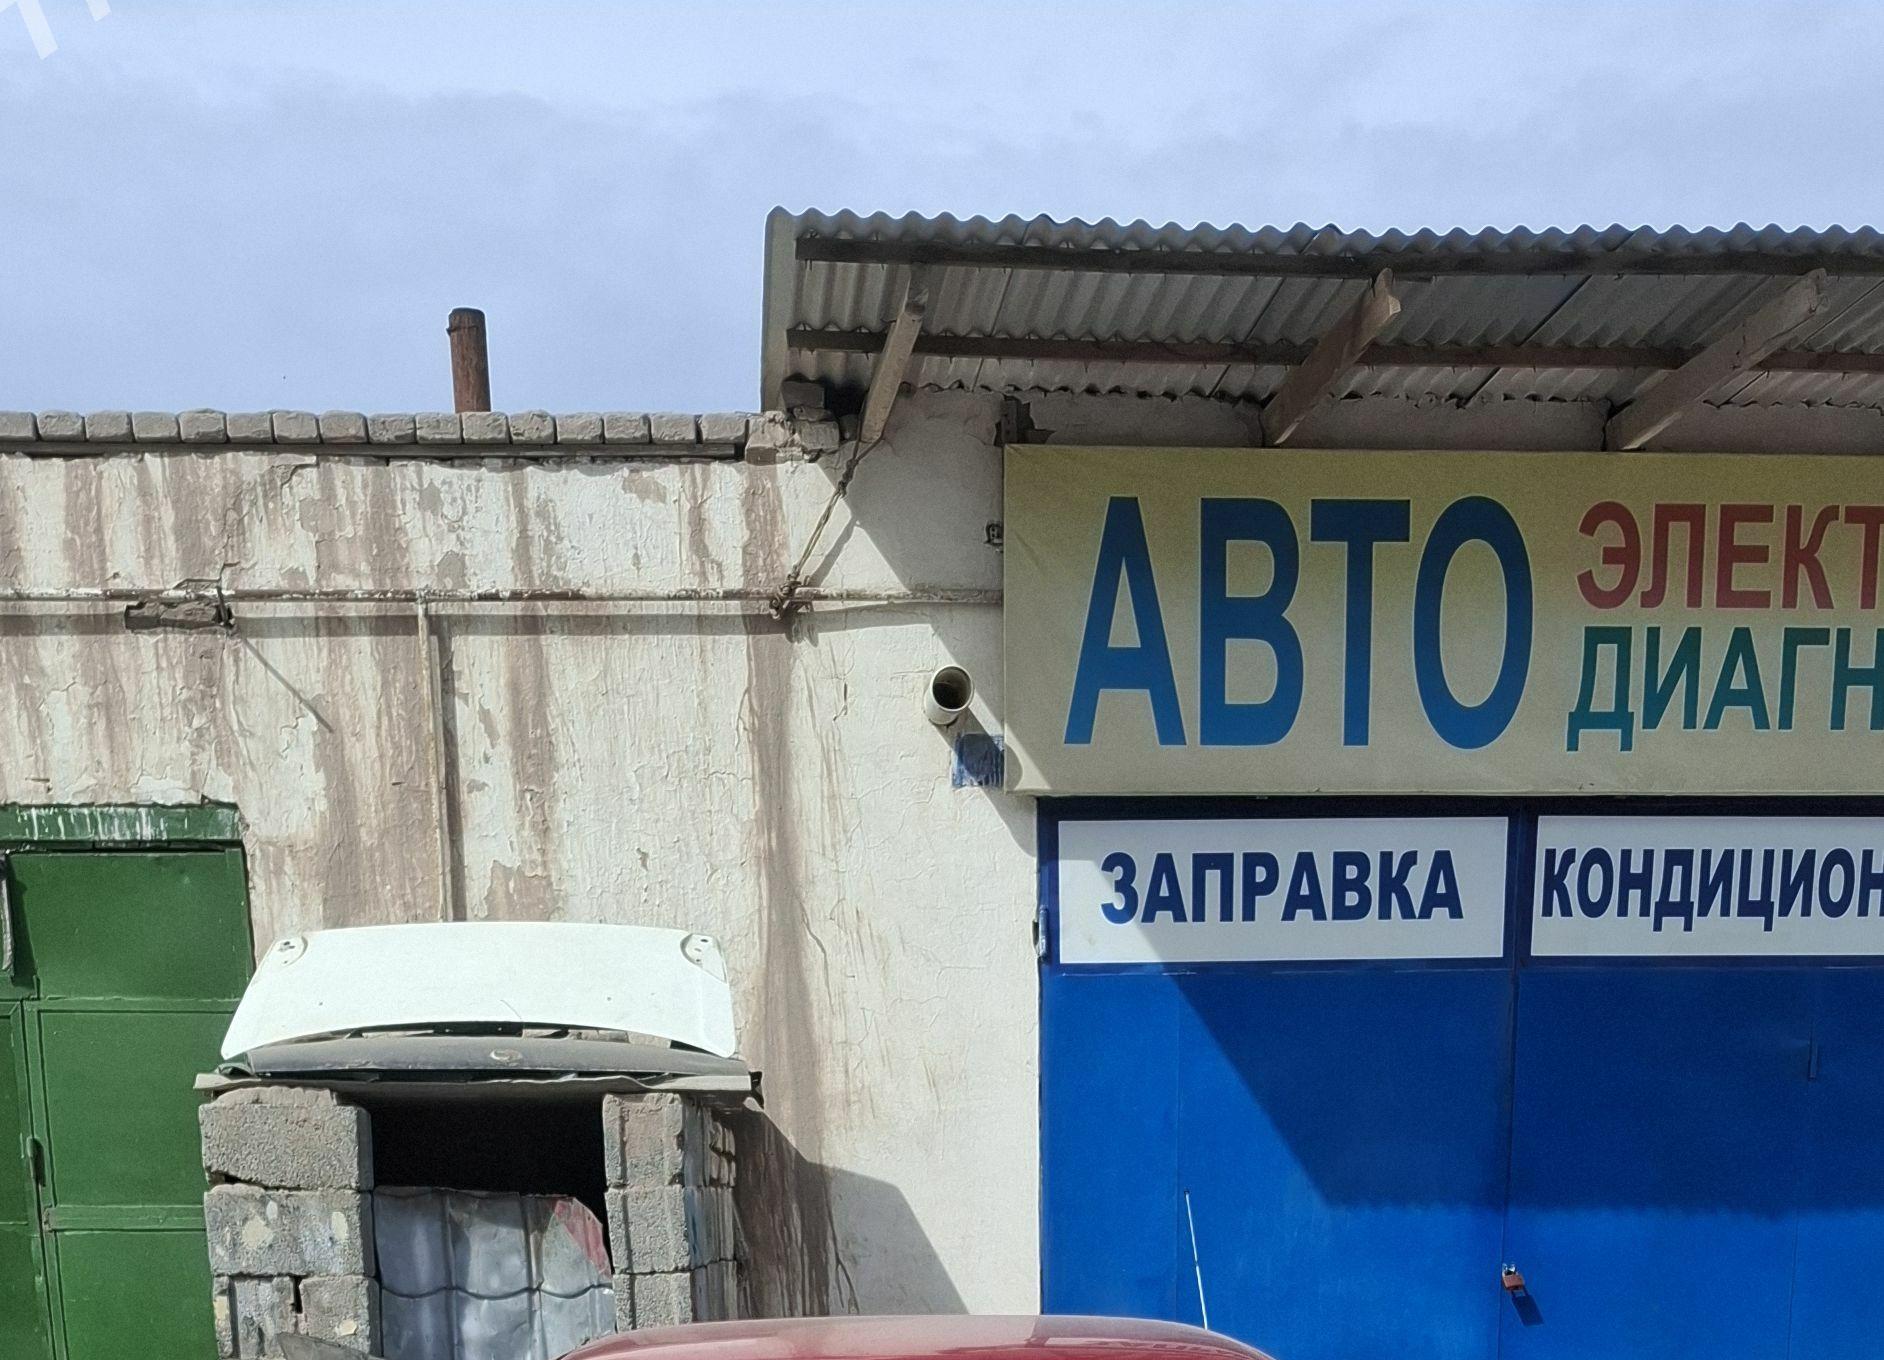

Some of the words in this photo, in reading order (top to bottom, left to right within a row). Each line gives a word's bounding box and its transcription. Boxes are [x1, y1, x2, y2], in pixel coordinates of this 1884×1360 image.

[1577, 502, 1884, 610] ЭЛЕКТ
[1064, 495, 1533, 749] АВТО
[1567, 626, 1884, 751] ДИАГН
[1101, 849, 1463, 924] ЗАПРАВКА
[1541, 847, 1884, 932] КОНДИЦИОН
